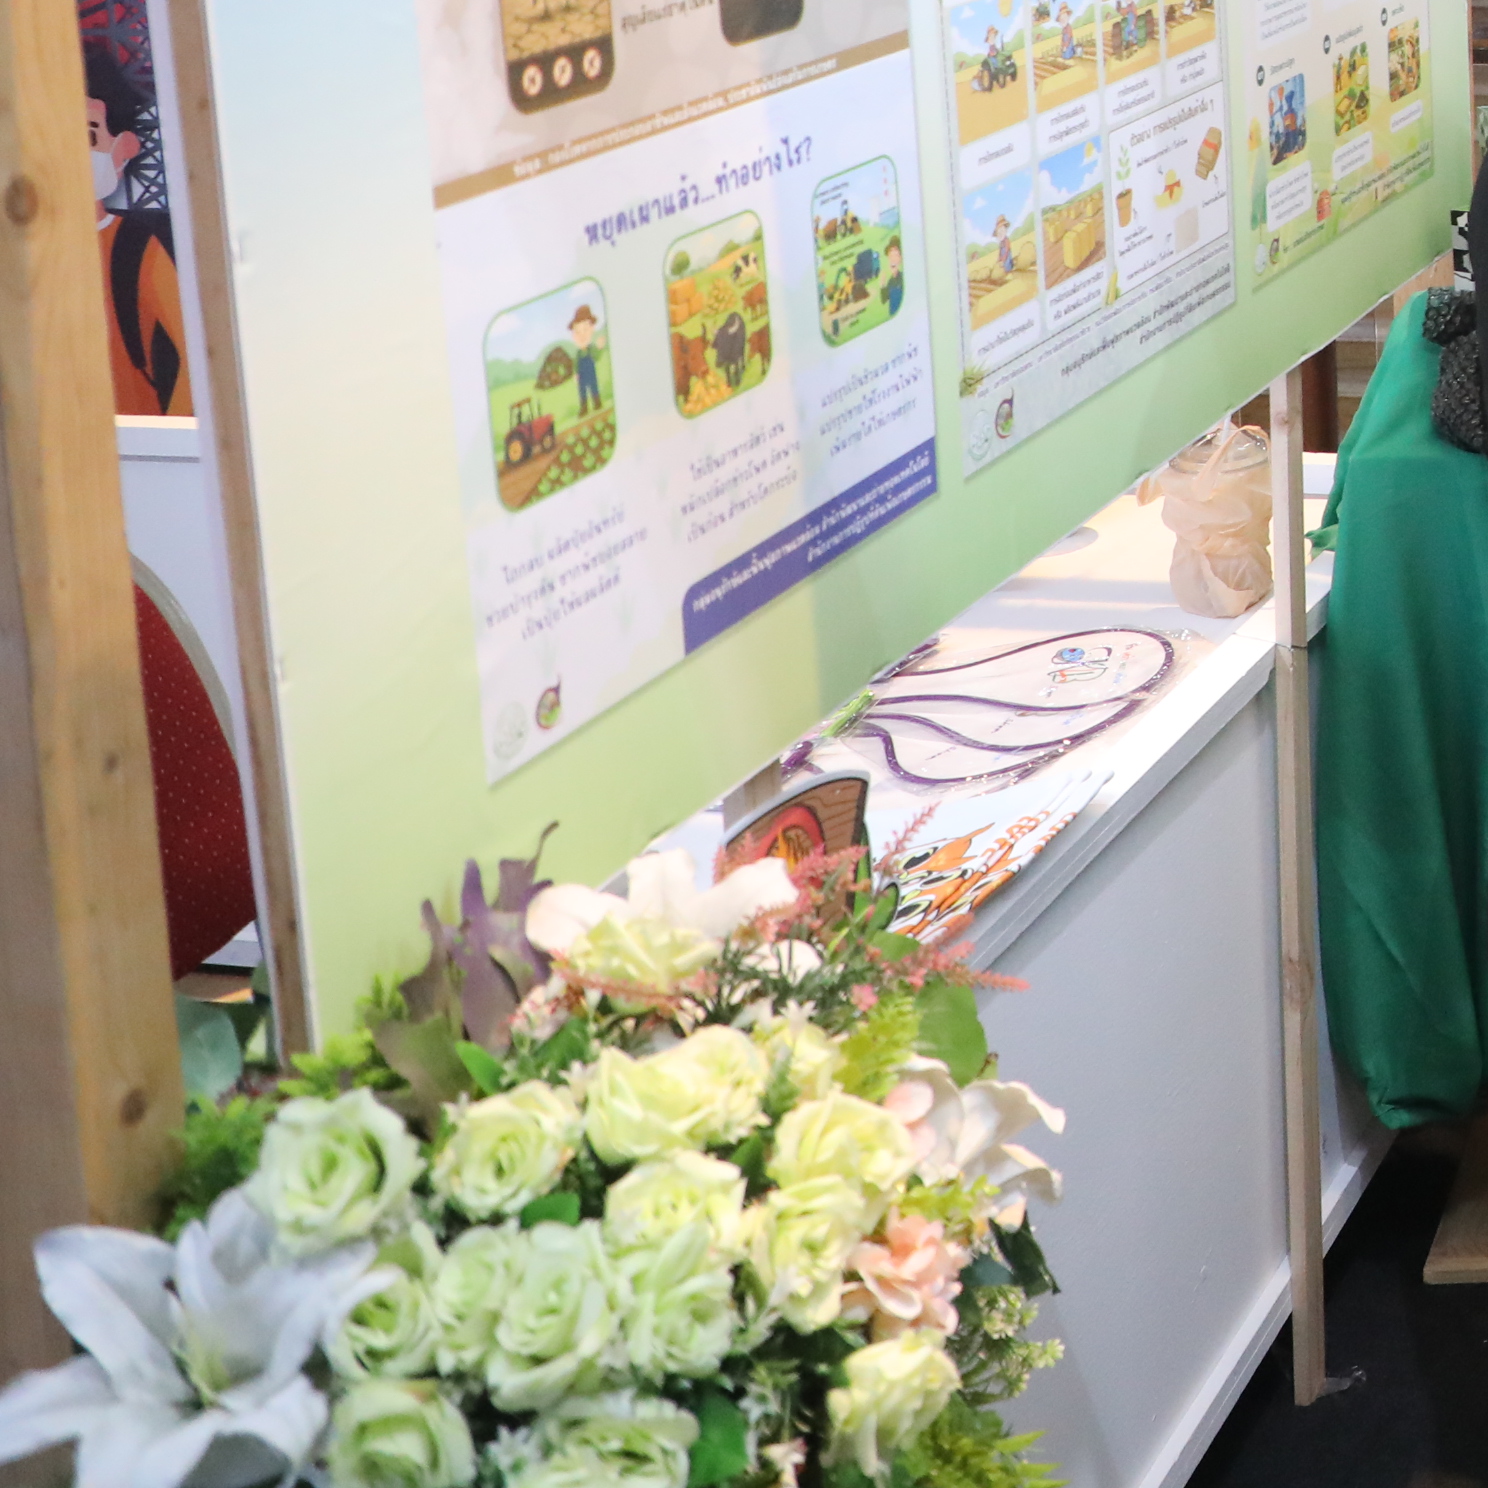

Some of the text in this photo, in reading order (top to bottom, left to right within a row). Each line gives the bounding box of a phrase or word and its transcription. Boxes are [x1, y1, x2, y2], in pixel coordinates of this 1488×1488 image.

[584, 136, 813, 249] หยุดเผาแล้ว...ทำอย่างไร?
